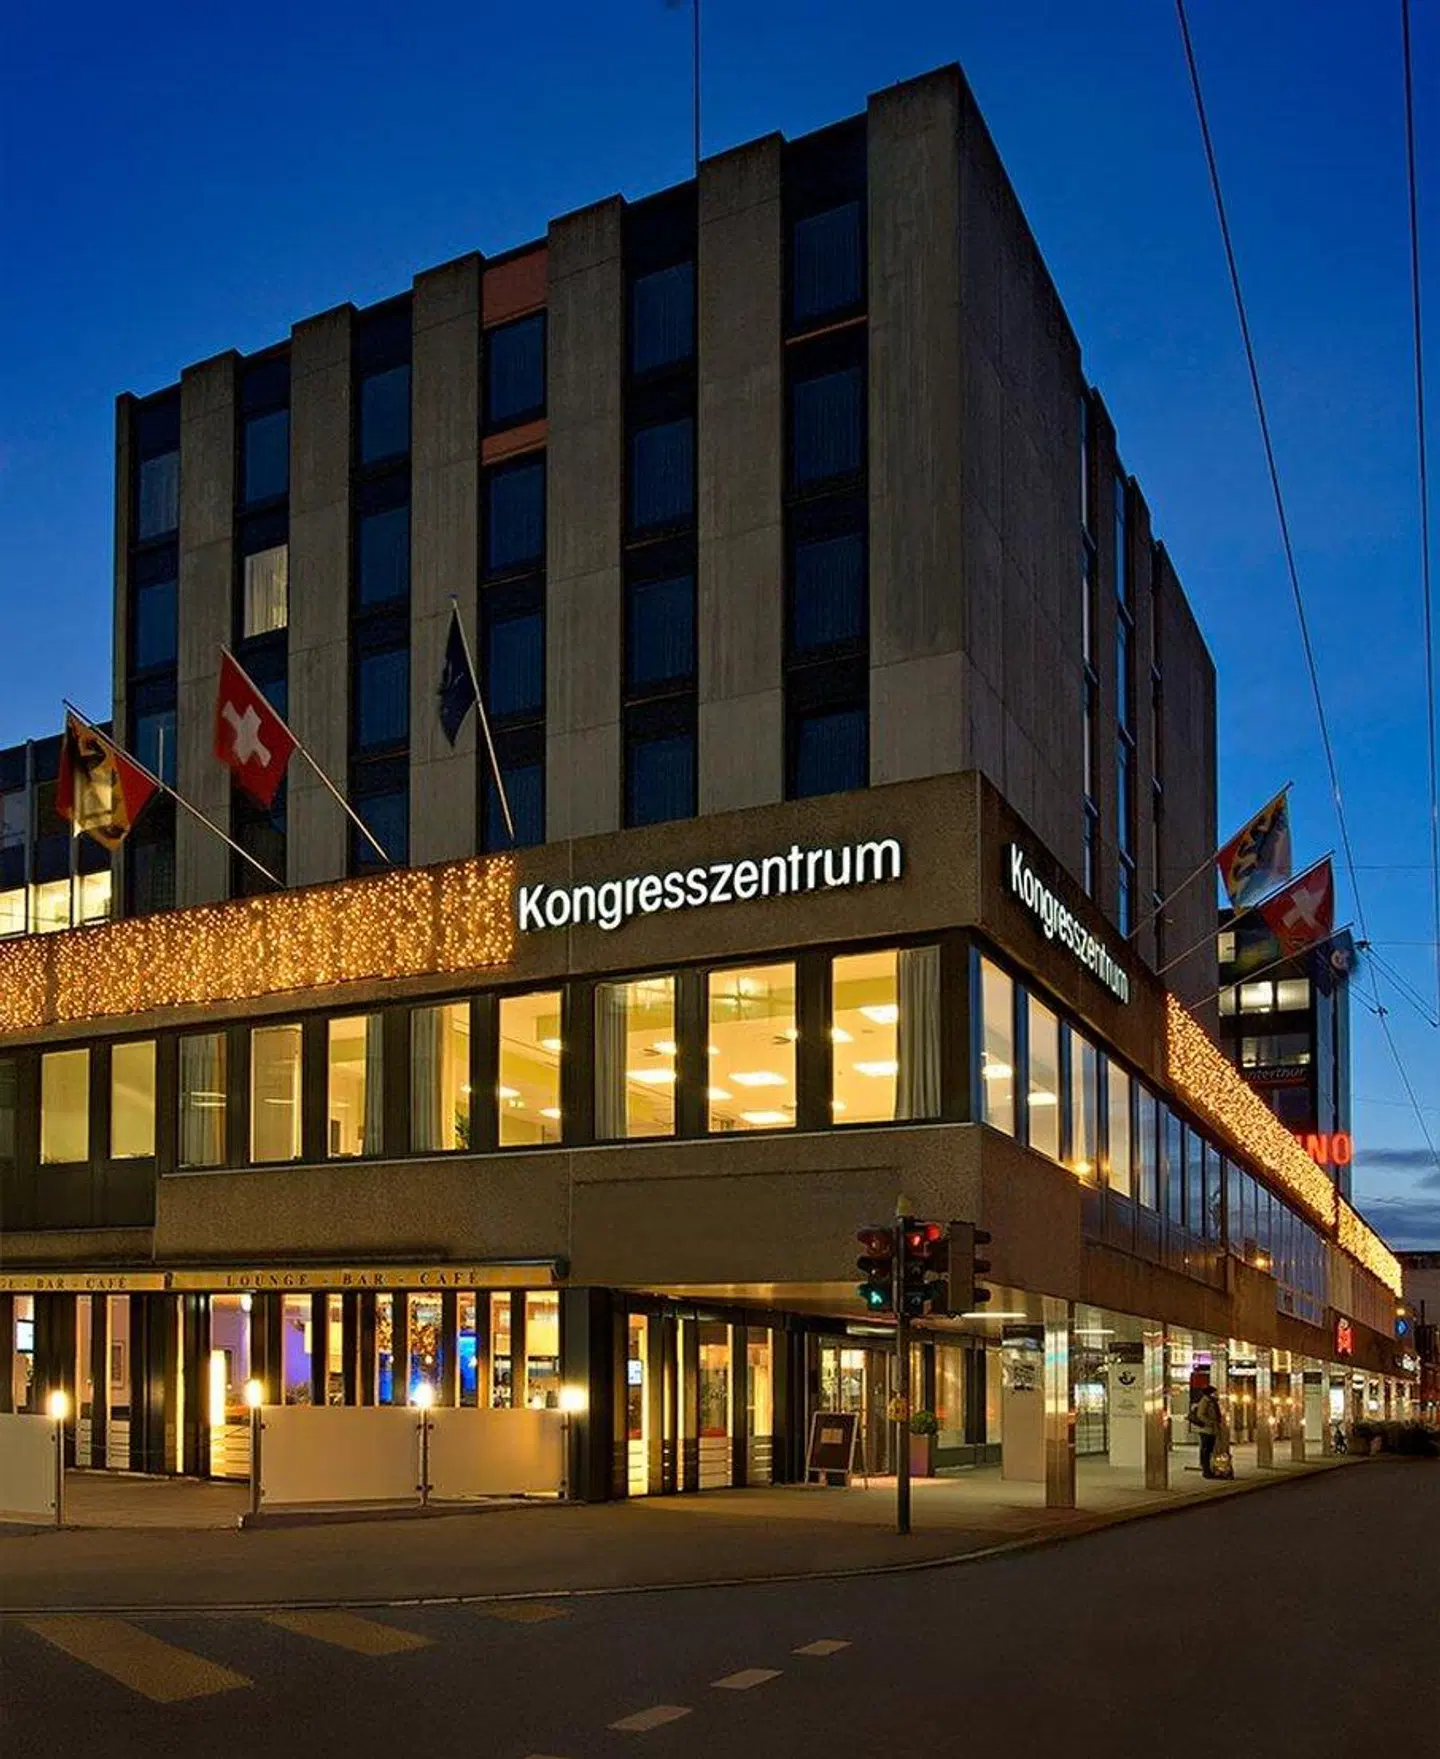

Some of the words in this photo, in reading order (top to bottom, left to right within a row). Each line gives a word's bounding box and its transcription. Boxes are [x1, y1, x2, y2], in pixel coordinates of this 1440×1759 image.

[518, 838, 901, 931] Kongresszentrum
[1010, 842, 1129, 1005] Kongresszentrum
[36, 1278, 65, 1289] BAR
[86, 1276, 127, 1289] CAFÉ
[226, 1273, 309, 1287] LOUNGE
[342, 1273, 385, 1285] BAR
[419, 1268, 480, 1285] CAFÉ
